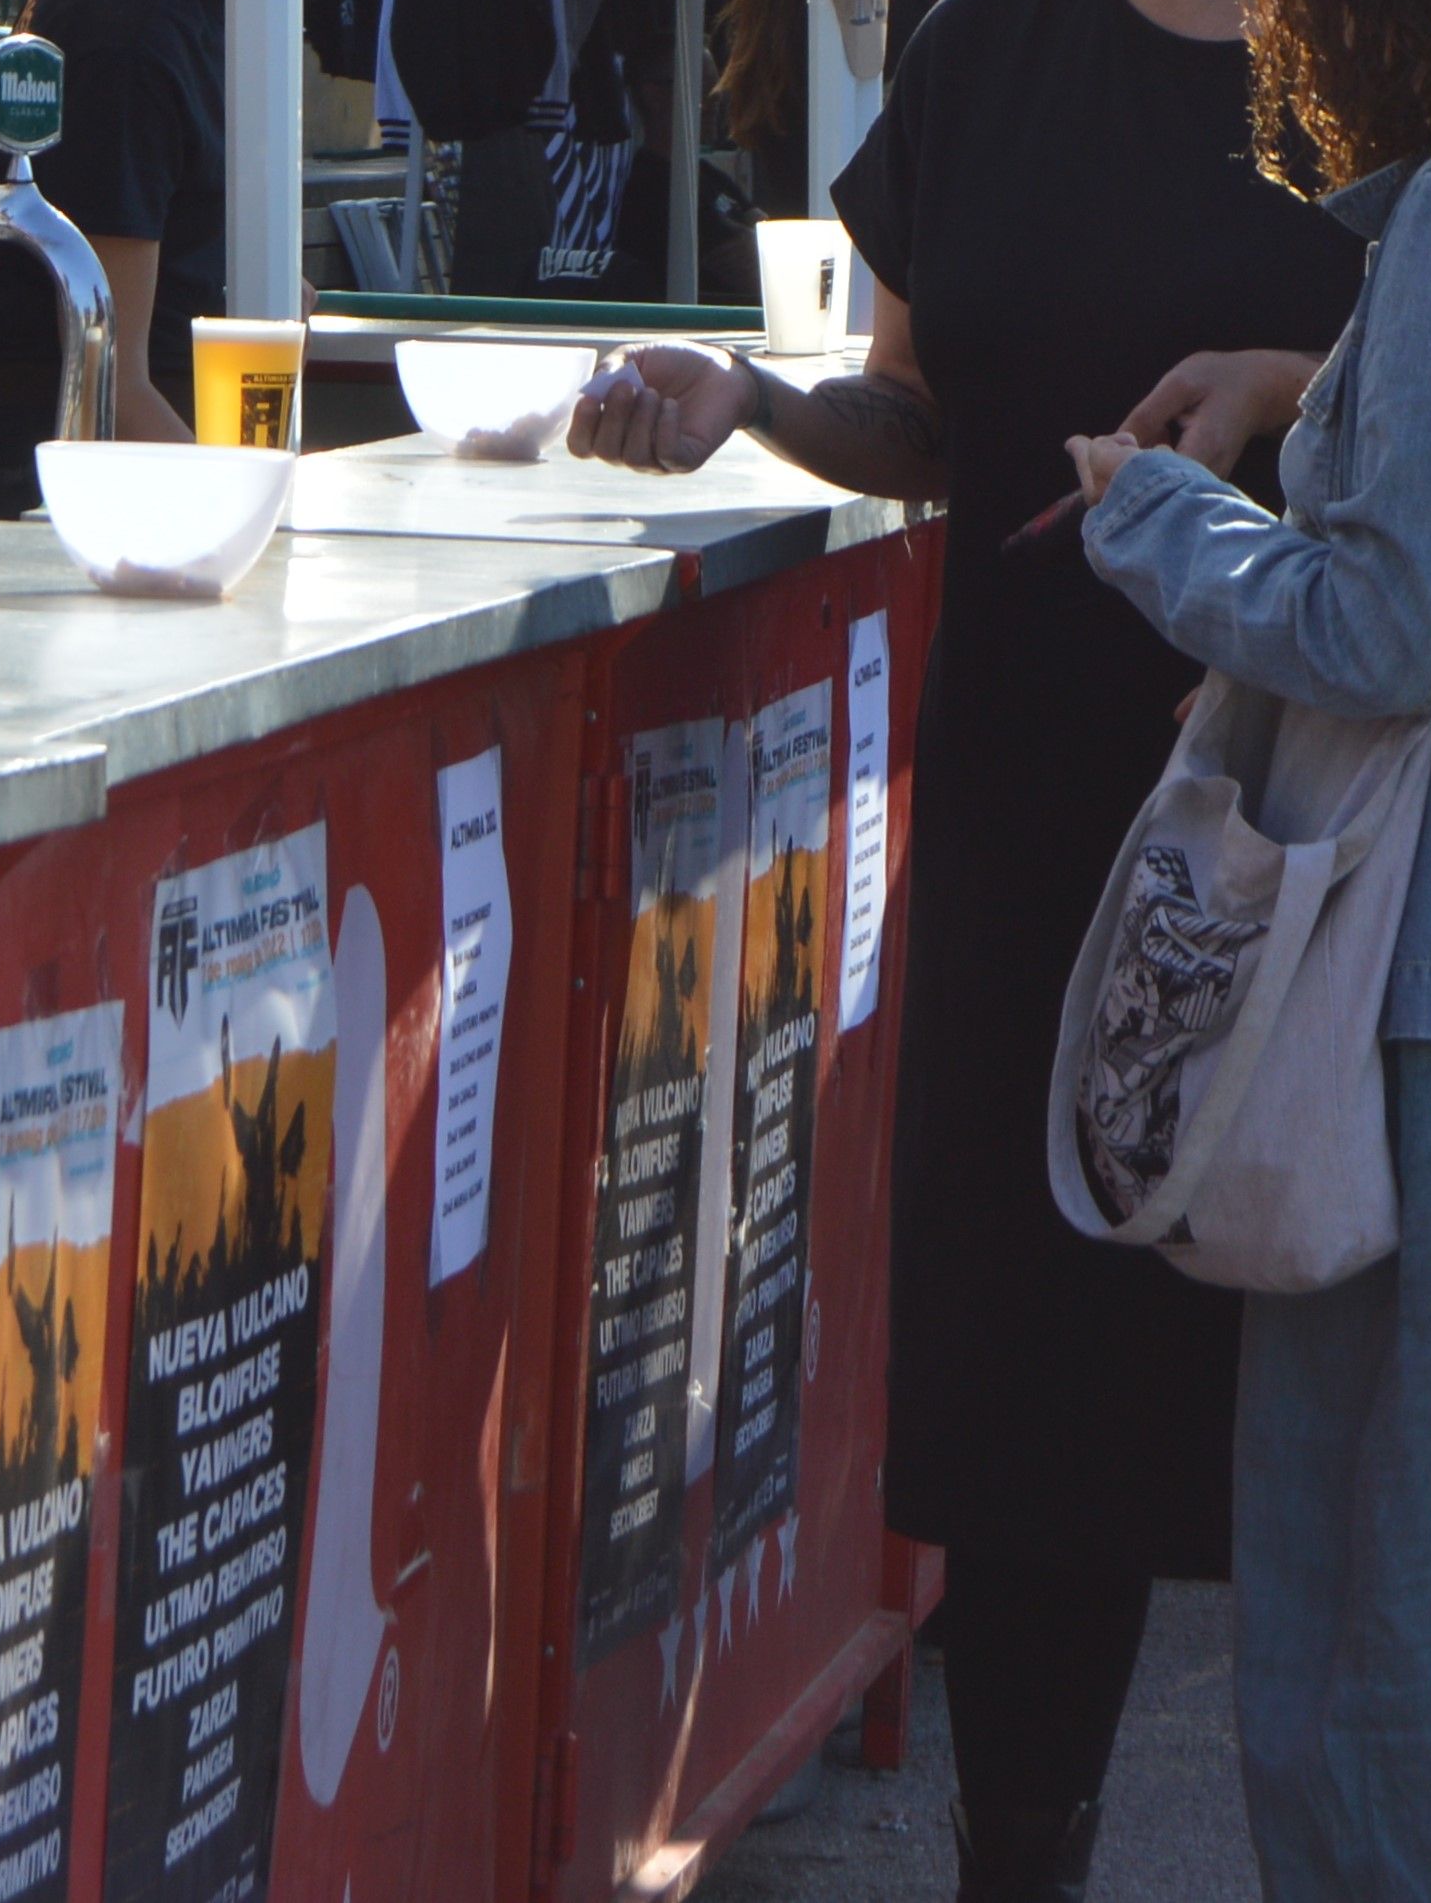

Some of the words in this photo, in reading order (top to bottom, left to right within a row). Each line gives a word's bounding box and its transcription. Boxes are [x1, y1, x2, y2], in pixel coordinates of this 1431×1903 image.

[0, 72, 57, 104] Mahou
[764, 1012, 815, 1069] VULCANO
[642, 1074, 699, 1126] VULCANO
[618, 1132, 680, 1188] BLOWFUSE
[618, 1187, 675, 1240] YAWNERS
[604, 1254, 630, 1299] THE
[632, 1234, 684, 1285] CAPACES
[148, 1308, 227, 1383] NUEVA
[231, 1262, 310, 1348] VULCANO
[599, 1306, 641, 1355] ULTIMO
[743, 1323, 775, 1372] ZARZA
[177, 1340, 281, 1436] BLOWFUSE
[596, 1360, 640, 1411] FUTURO
[181, 1407, 274, 1496] YAWNERS
[623, 1404, 656, 1450] ZARZA
[620, 1449, 654, 1493] PANGEA
[157, 1510, 199, 1574] THE
[203, 1460, 286, 1552] CAPACES
[144, 1571, 214, 1648] ULTIMO
[216, 1525, 286, 1608] REKURSO
[132, 1636, 209, 1716] FUTURO
[212, 1584, 284, 1671] PRIMITIVO
[188, 1679, 238, 1751] ZARZA
[182, 1733, 234, 1804] PANGEA
[165, 1776, 241, 1870] SECONDBEST
